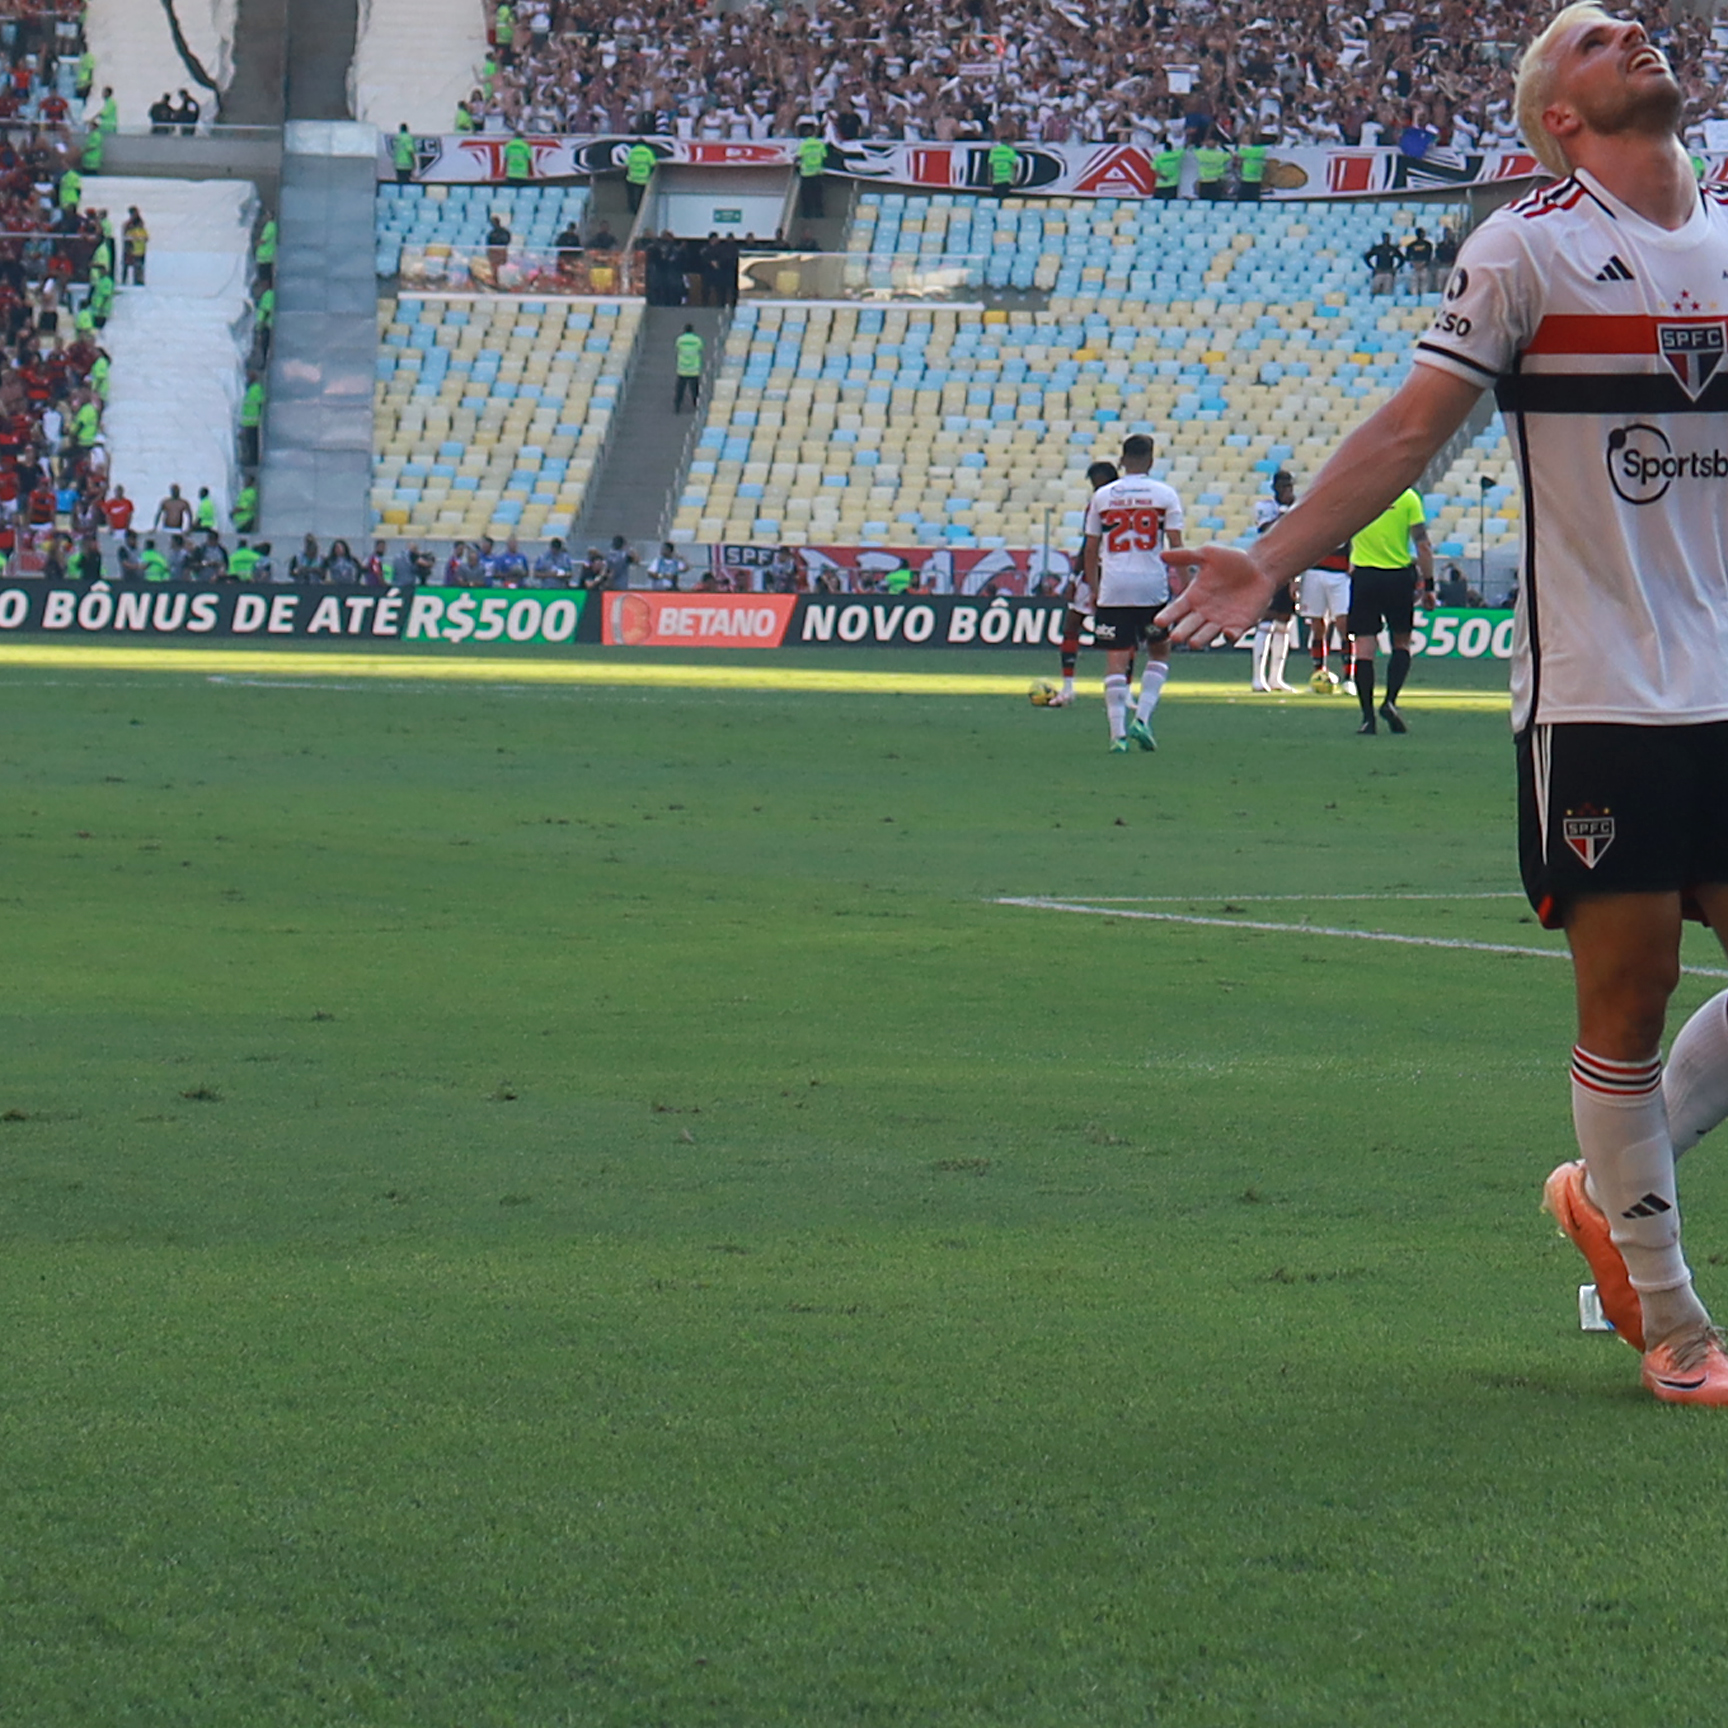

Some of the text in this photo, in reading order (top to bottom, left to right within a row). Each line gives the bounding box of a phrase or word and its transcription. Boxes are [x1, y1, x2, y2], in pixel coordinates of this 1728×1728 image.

[1663, 329, 1721, 348] SPFC
[1106, 510, 1159, 553] 29
[725, 546, 776, 566] SPF
[42, 581, 219, 633] BÔNUS
[232, 594, 299, 633] DE
[307, 588, 403, 635] ATÉ
[405, 592, 578, 642] R$500
[657, 607, 776, 638] BETANO
[801, 604, 936, 644] NOVO
[1566, 819, 1611, 837] SPFC
